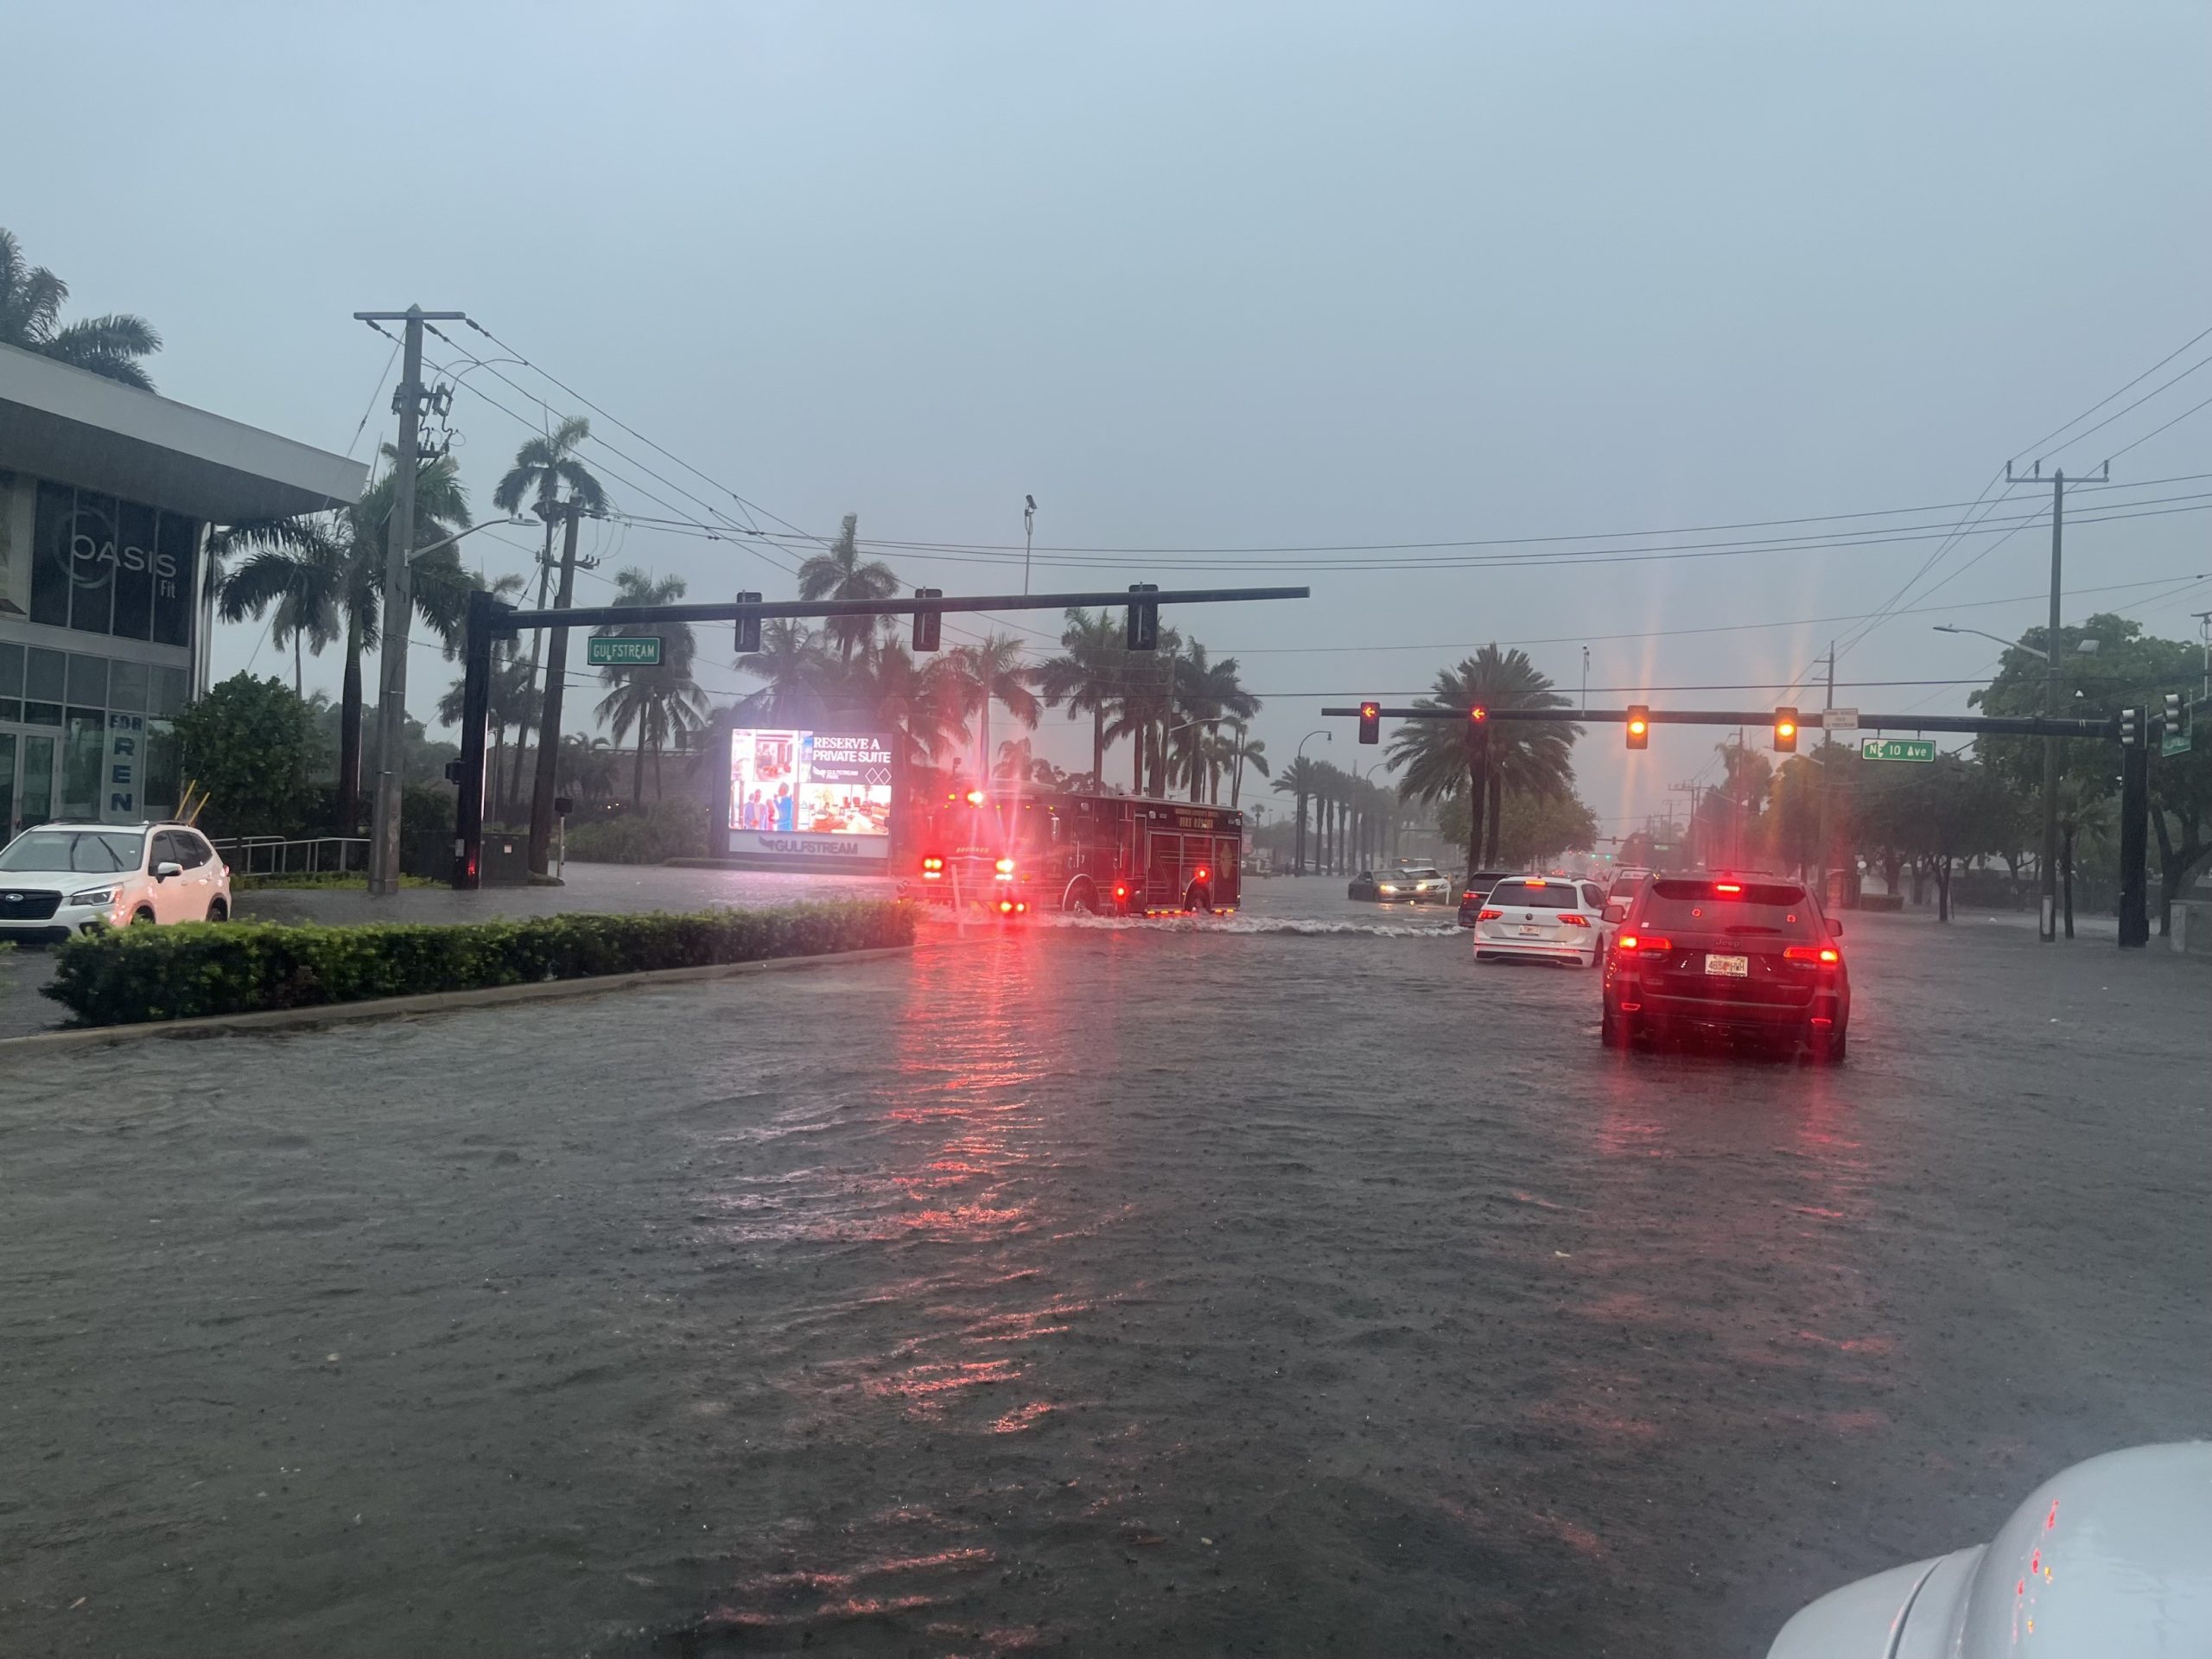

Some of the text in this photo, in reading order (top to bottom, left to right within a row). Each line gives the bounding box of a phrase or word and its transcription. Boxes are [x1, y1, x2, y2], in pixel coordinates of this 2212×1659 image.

[73, 535, 176, 577] OASIS
[161, 580, 175, 598] Fit
[594, 645, 655, 658] GULFSTREAM
[110, 715, 142, 731] FOR
[813, 737, 880, 750] RESERVE A
[813, 750, 891, 763] PRIVATE SUITE
[1869, 745, 1927, 757] NE 10 Ave
[111, 737, 135, 811] REN
[776, 840, 858, 855] GULFSTREAM
[1714, 938, 1741, 948] Jeep
